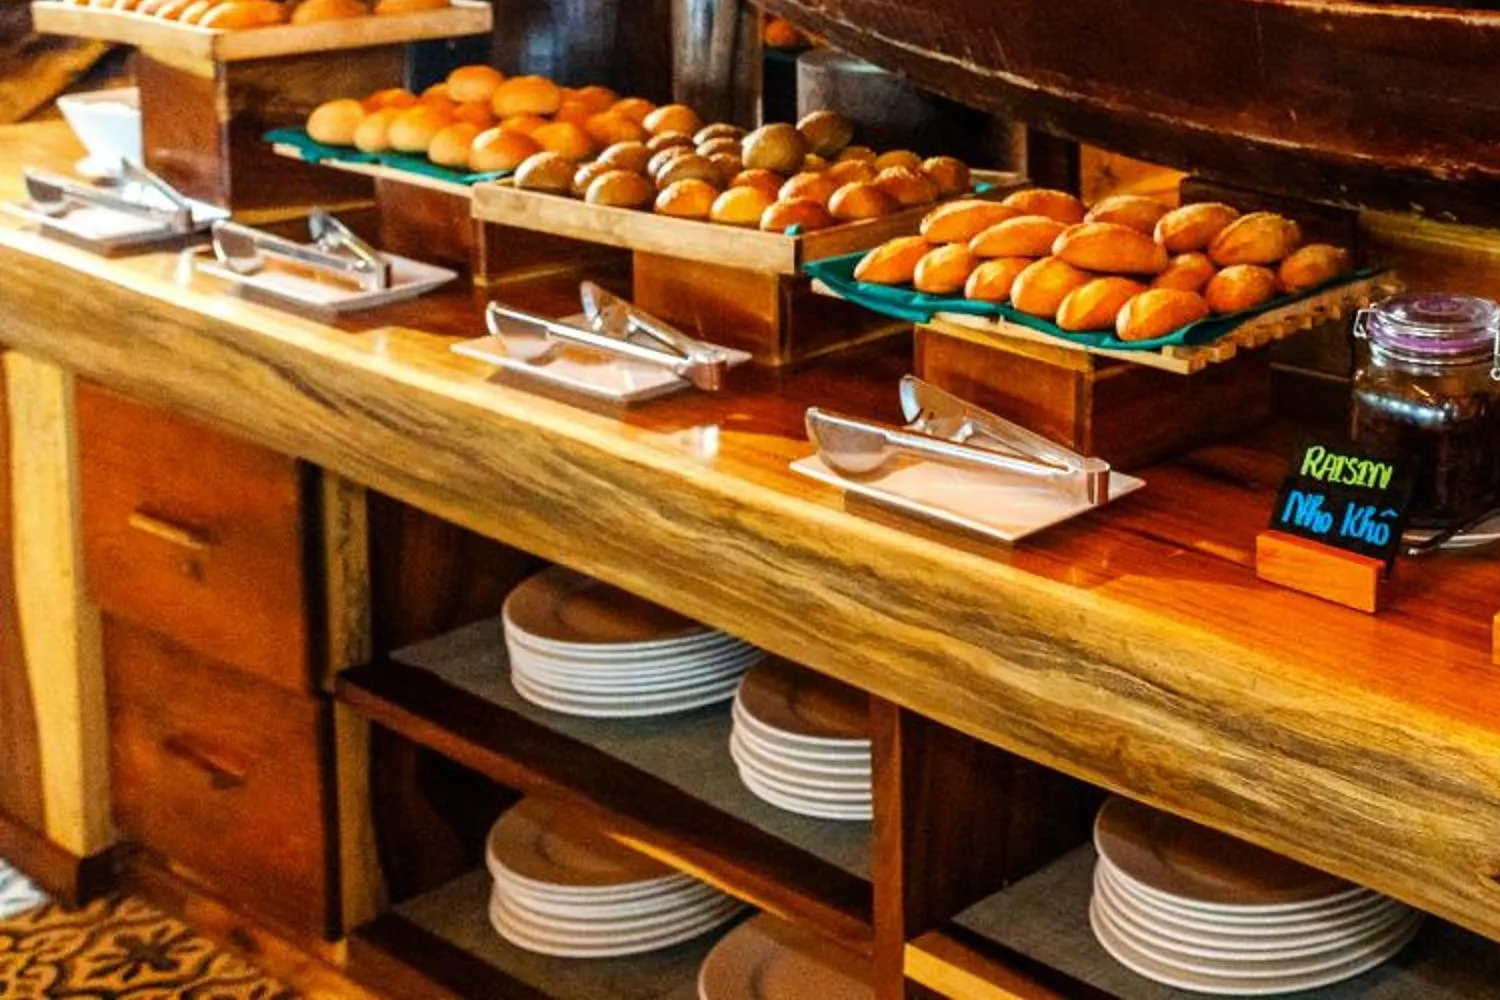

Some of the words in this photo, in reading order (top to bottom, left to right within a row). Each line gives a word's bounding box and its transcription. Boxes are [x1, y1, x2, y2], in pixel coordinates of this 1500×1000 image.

[1301, 445, 1393, 490] RAISIN
[1281, 489, 1334, 533] Nho
[1340, 502, 1399, 546] Khô
